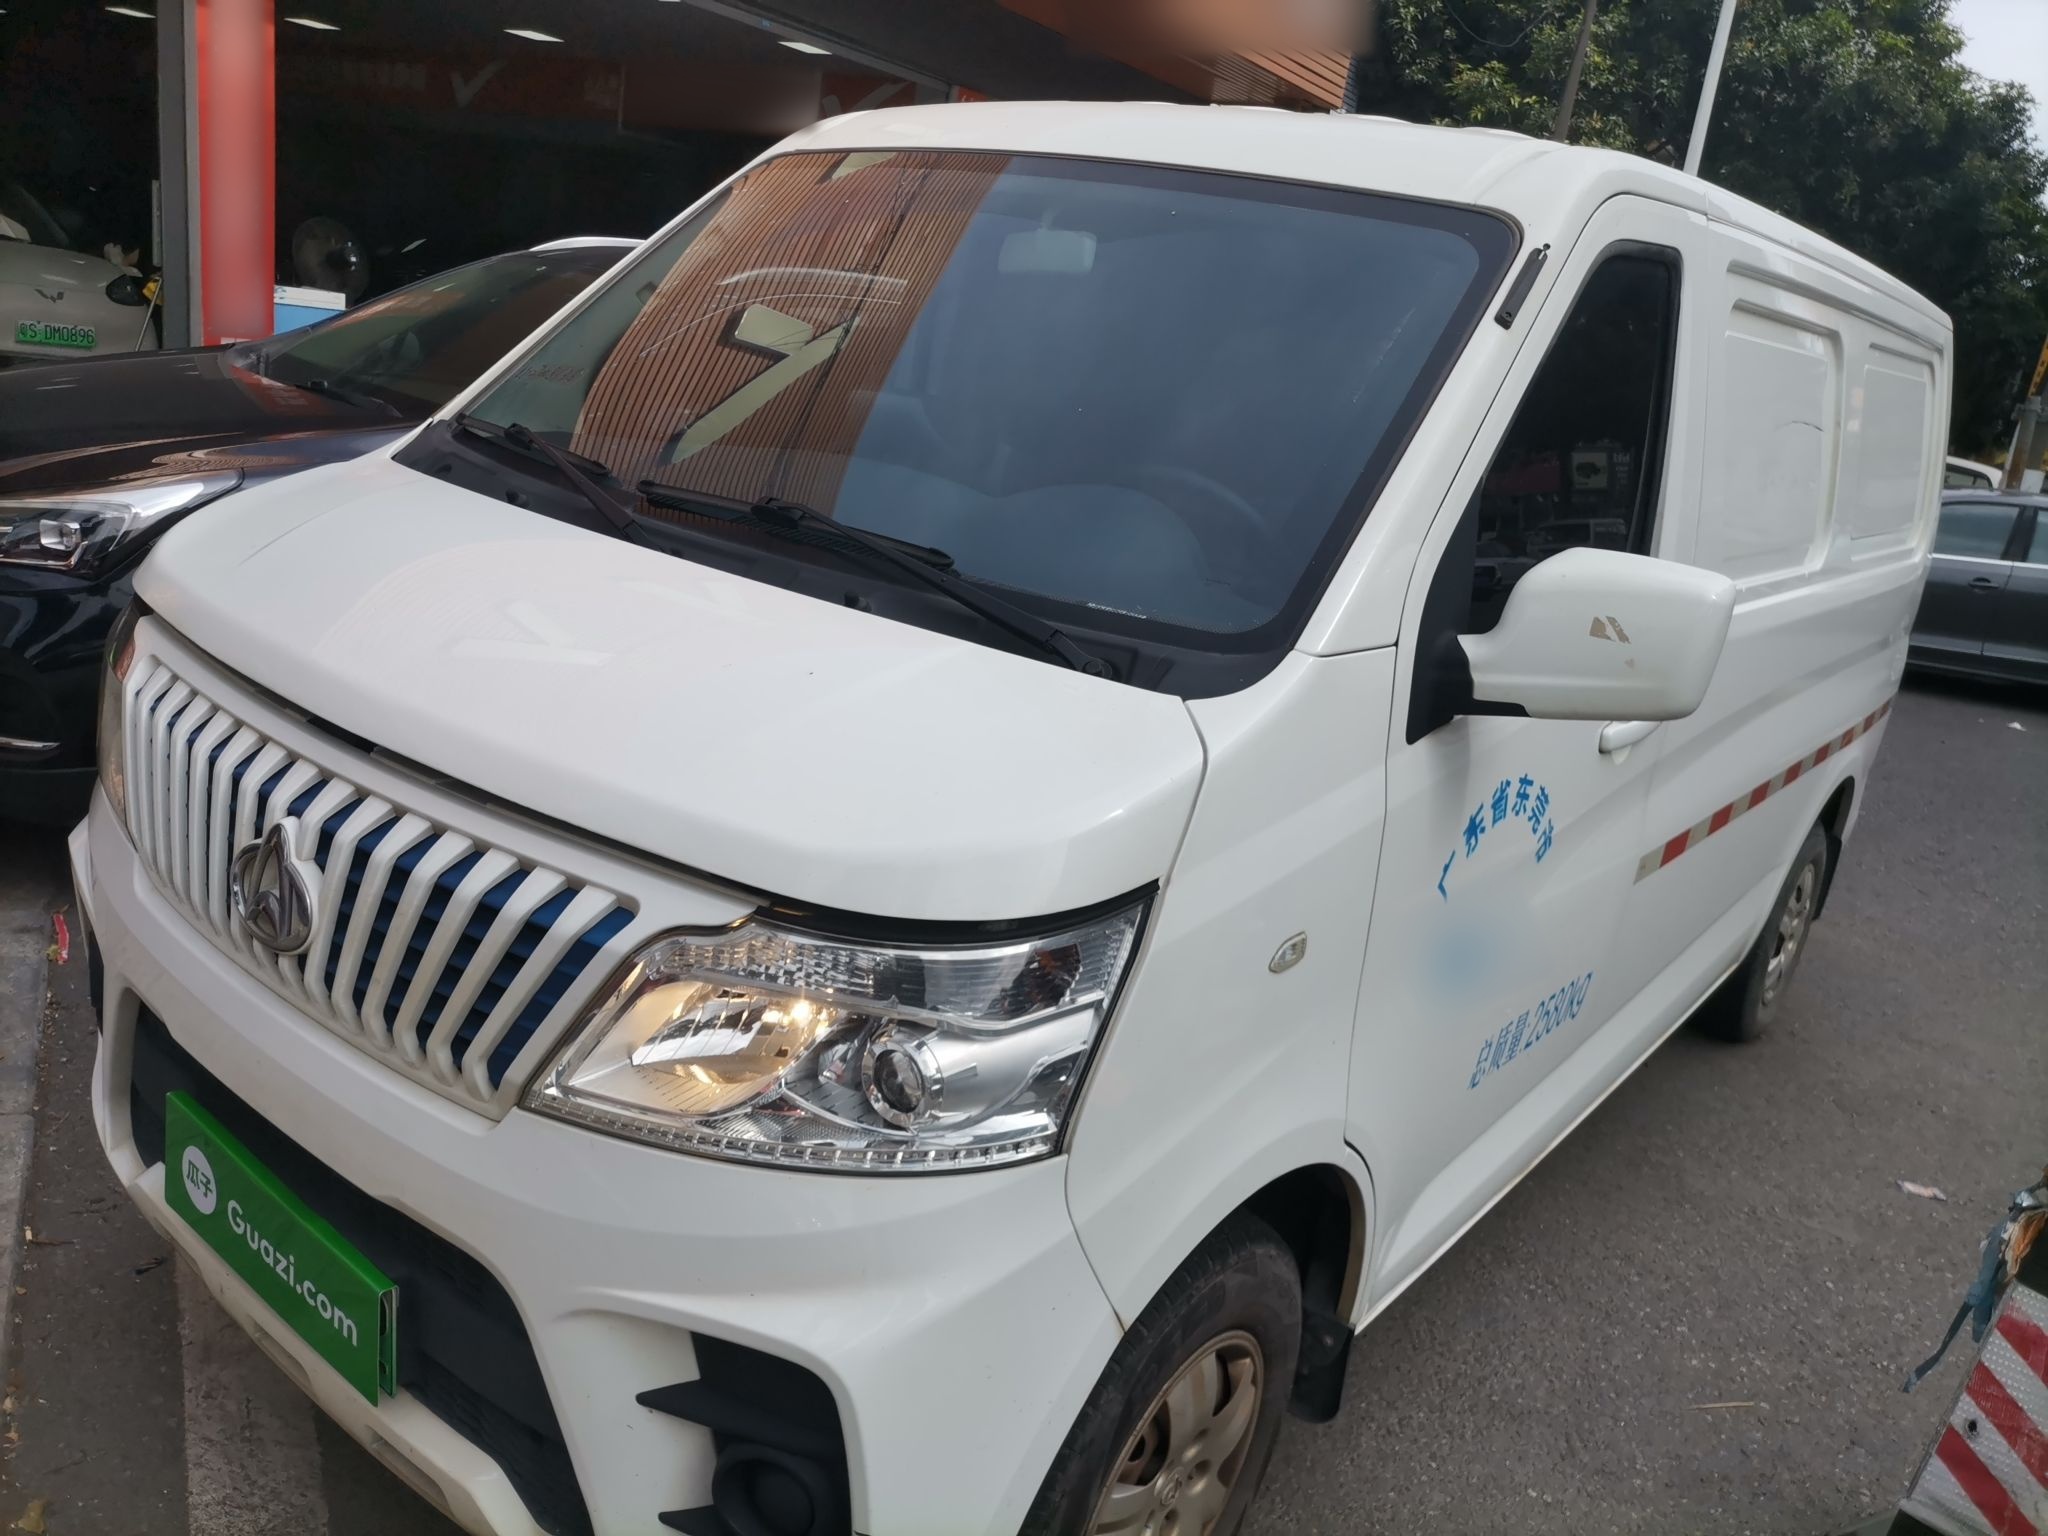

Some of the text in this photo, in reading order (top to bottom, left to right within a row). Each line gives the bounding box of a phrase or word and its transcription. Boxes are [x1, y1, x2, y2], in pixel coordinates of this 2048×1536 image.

[1437, 773, 1555, 903] 广东省东莞市
[185, 1159, 214, 1198] 瓜子
[227, 1199, 358, 1347] Guazi.com
